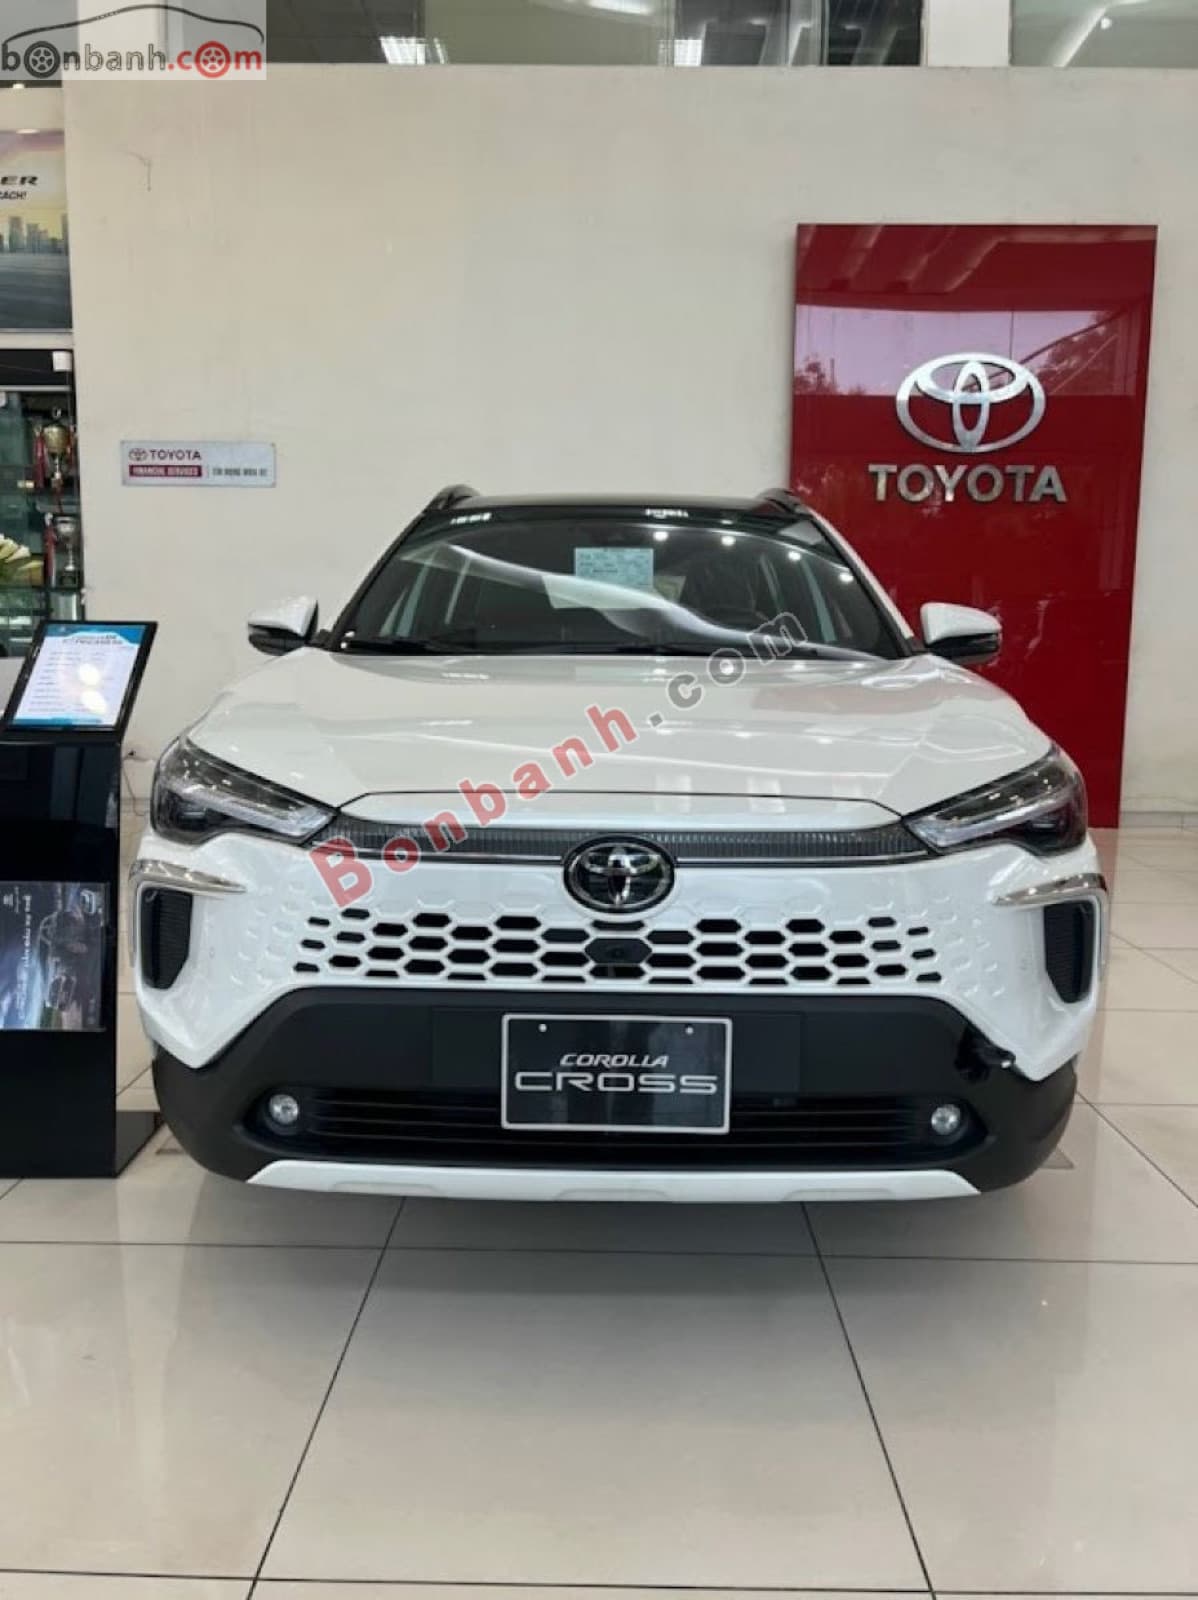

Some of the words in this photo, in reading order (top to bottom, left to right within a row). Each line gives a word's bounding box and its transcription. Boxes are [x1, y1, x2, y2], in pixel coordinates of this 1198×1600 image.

[150, 449, 202, 461] TOYOTA
[868, 463, 1067, 502] TOYOTA
[559, 1053, 670, 1068] COROLLA
[514, 1071, 719, 1096] CROSS
